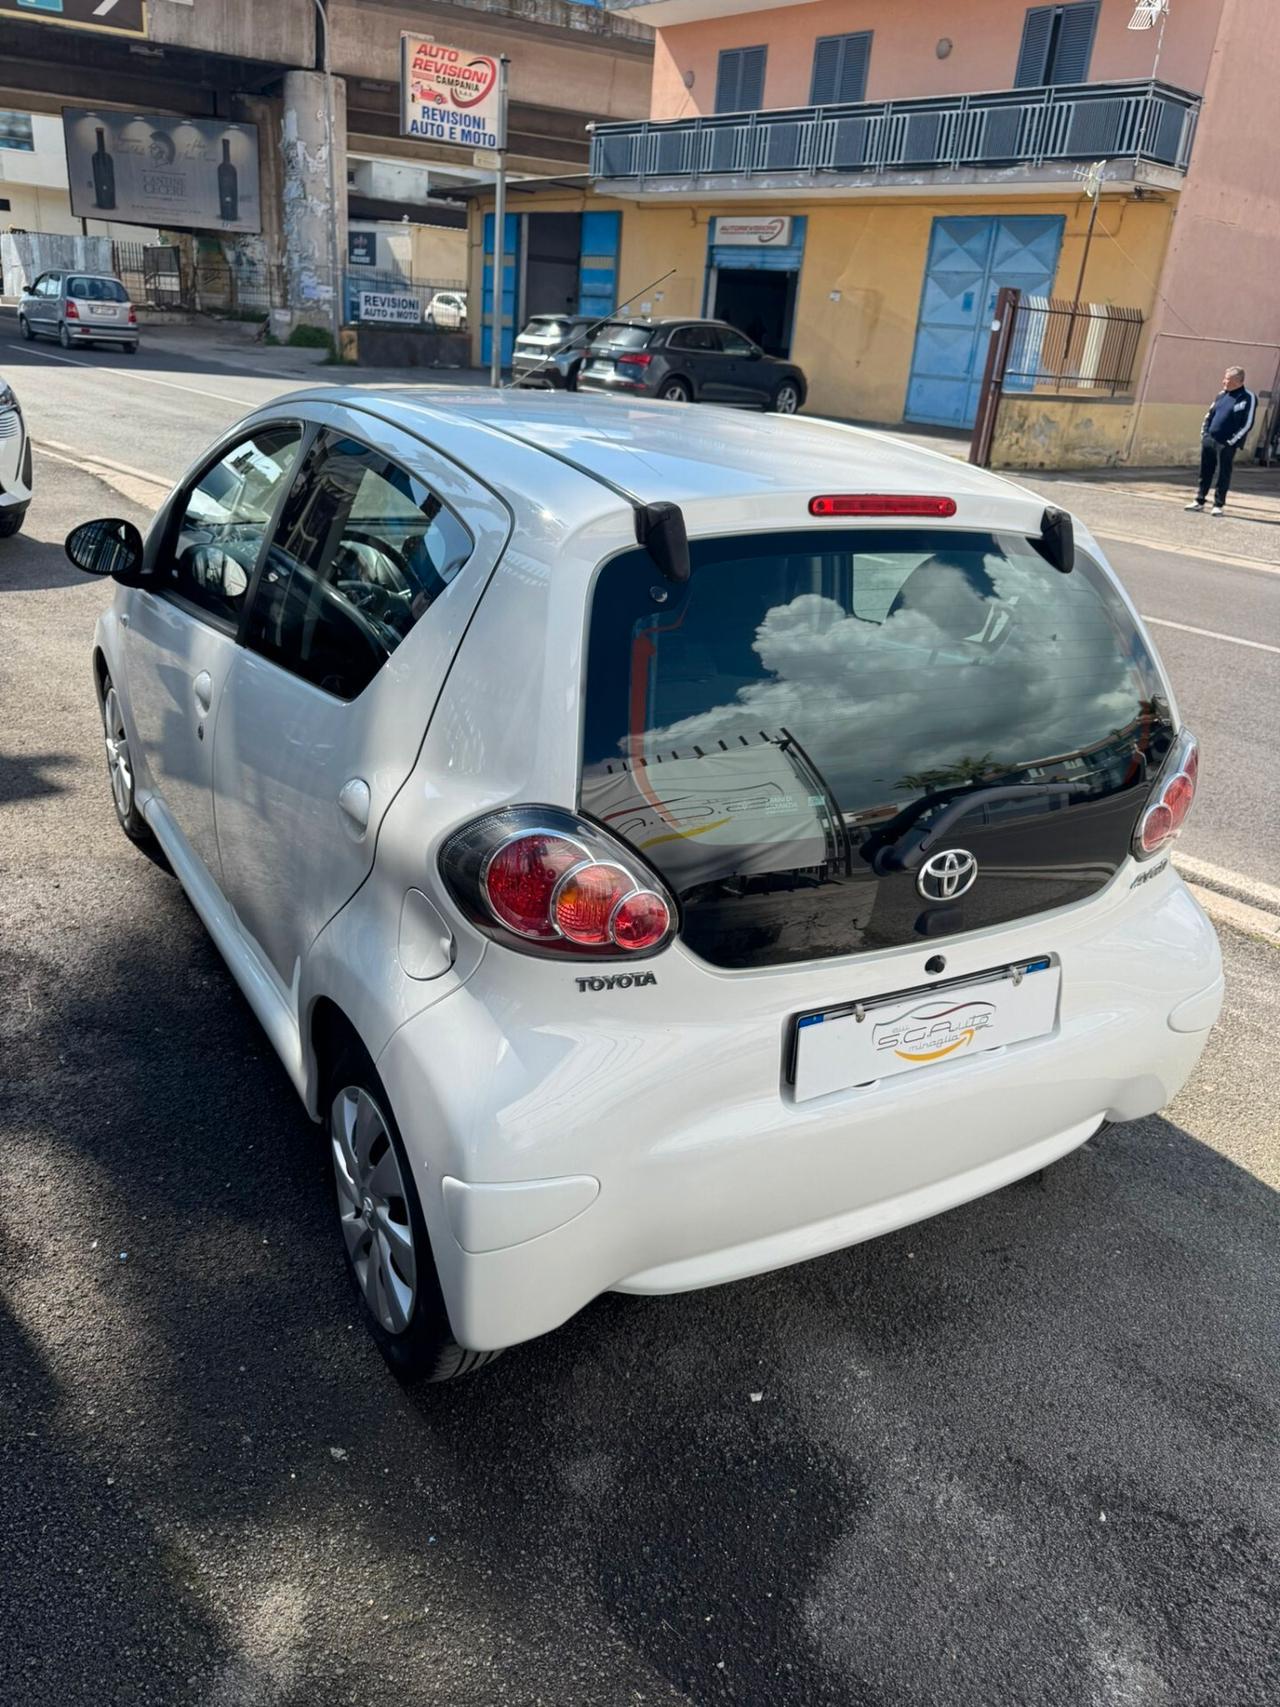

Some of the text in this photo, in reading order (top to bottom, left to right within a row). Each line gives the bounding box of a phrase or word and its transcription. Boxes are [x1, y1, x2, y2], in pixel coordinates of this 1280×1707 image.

[416, 43, 459, 62] AUTO
[412, 57, 488, 84] REVISIONI
[435, 75, 480, 92] CAMPANIA
[421, 106, 486, 130] REVISIONI
[410, 120, 496, 147] AUTO E MOTO
[364, 295, 419, 311] REVISIONI
[364, 307, 388, 318] AUTO
[396, 310, 419, 321] MOTO
[575, 970, 657, 993] TOYOTA
